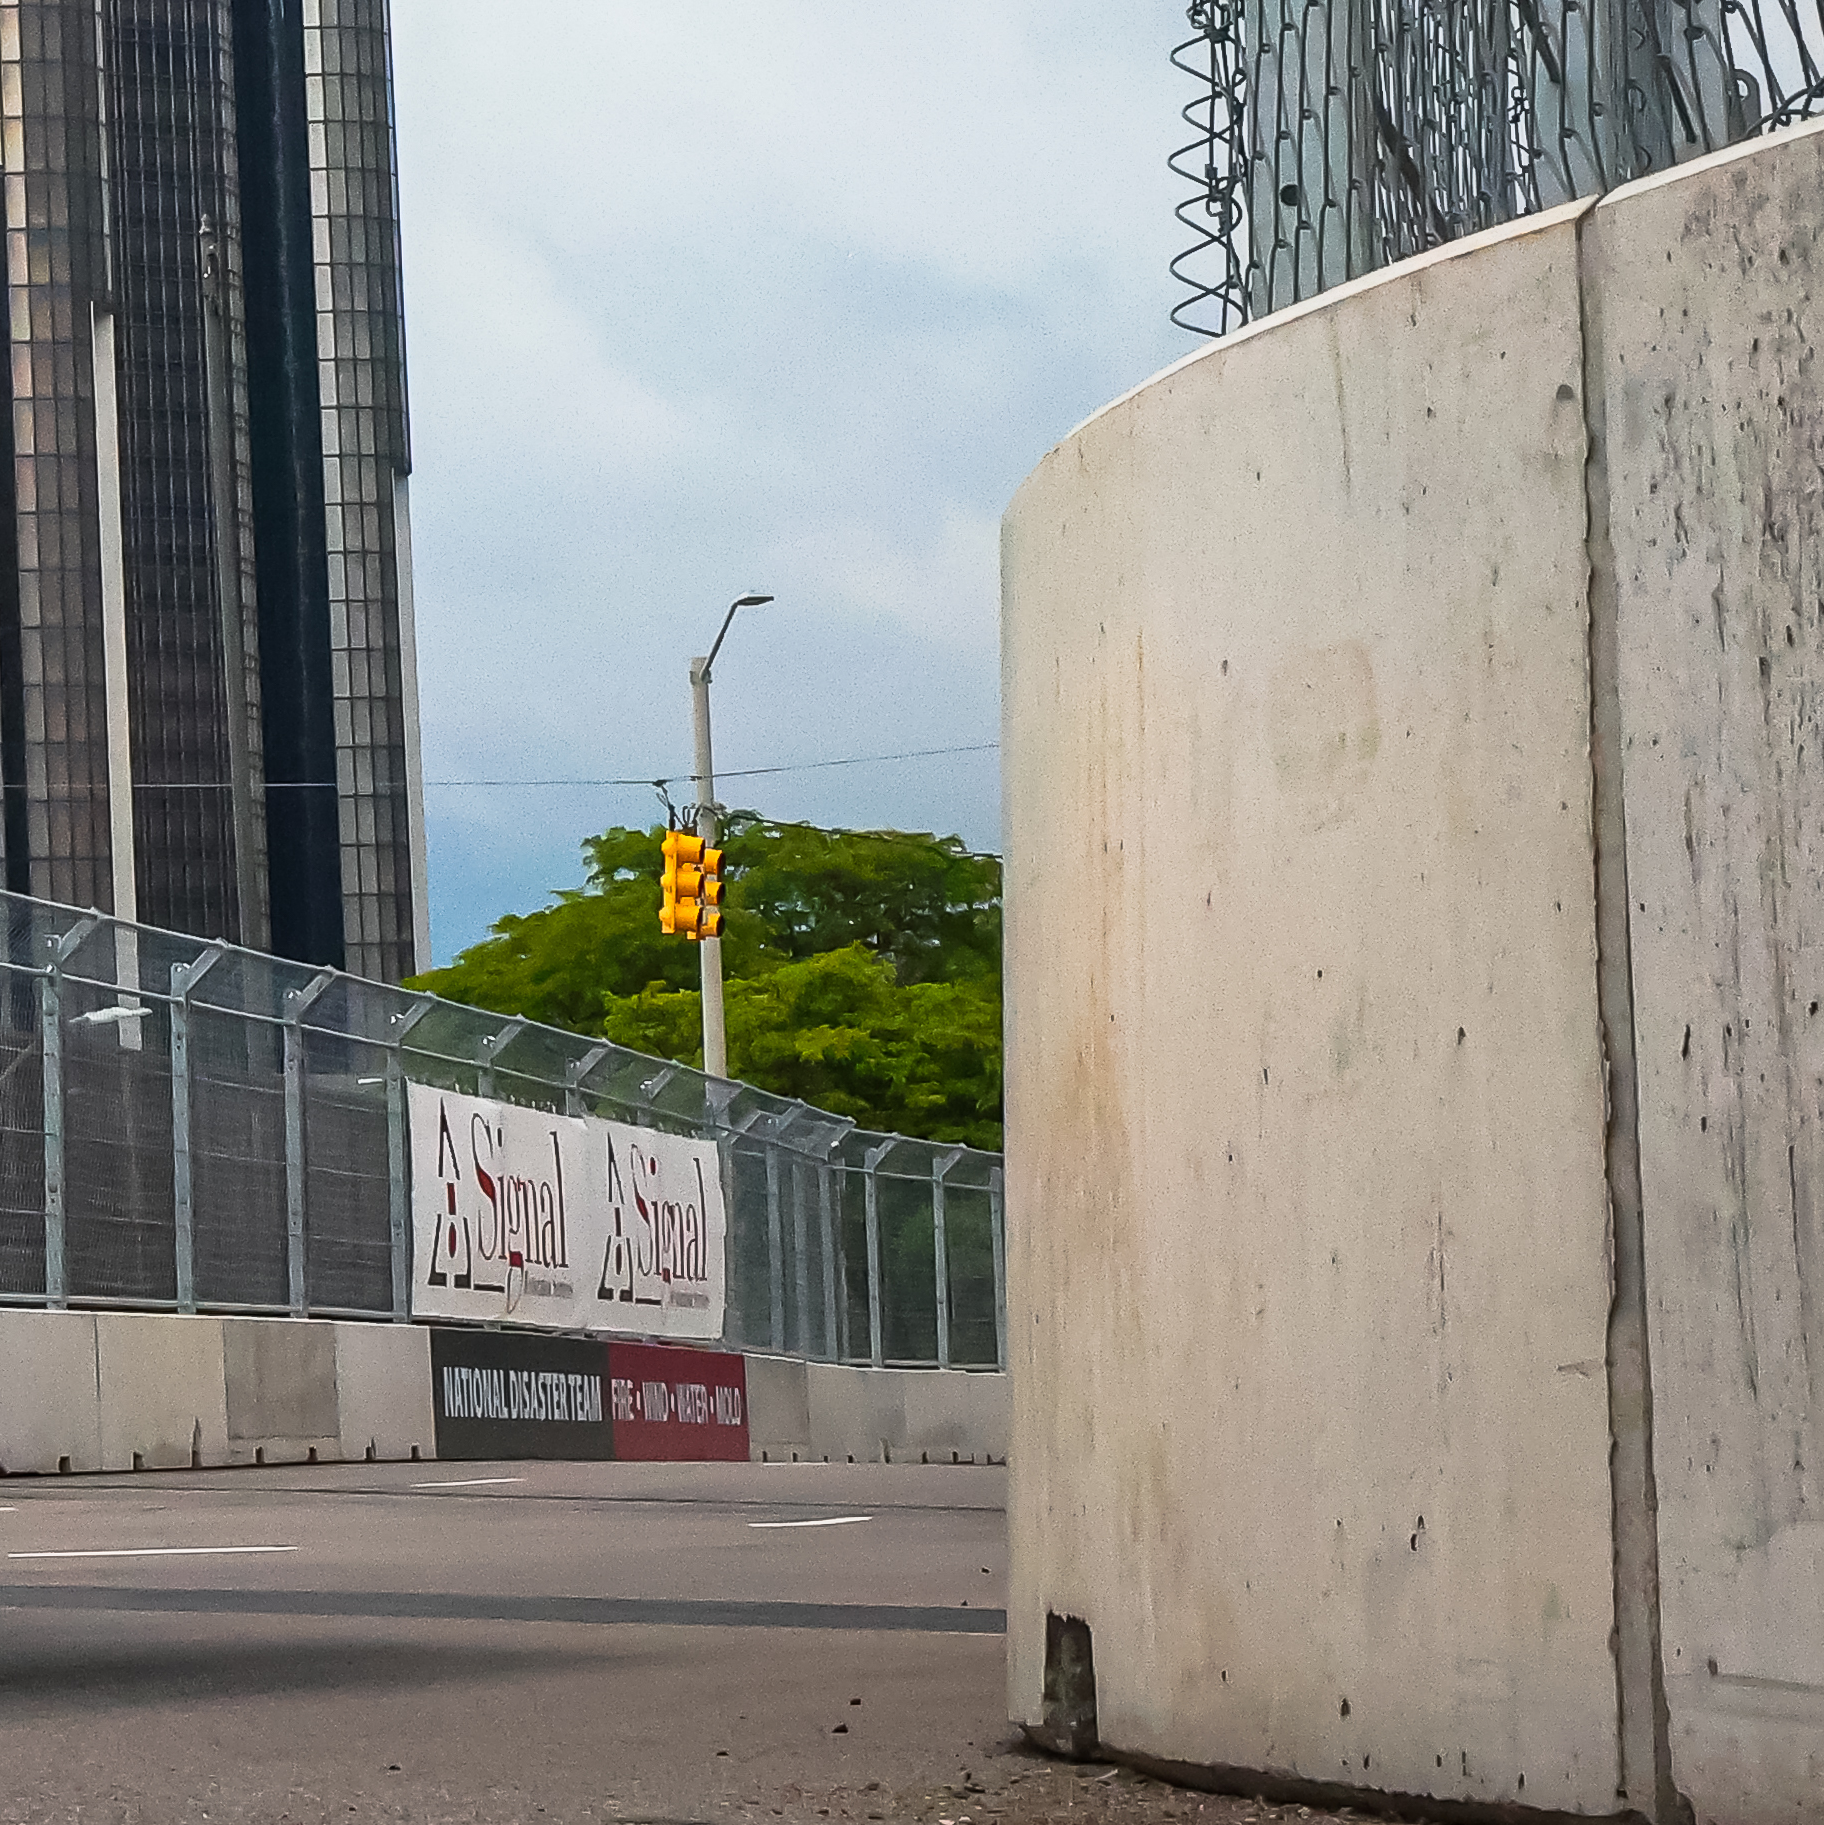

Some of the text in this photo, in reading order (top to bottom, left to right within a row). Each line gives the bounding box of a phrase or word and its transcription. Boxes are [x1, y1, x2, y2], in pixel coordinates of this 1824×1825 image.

[443, 1366, 603, 1422] NATIONAL DISASTER TEAM
